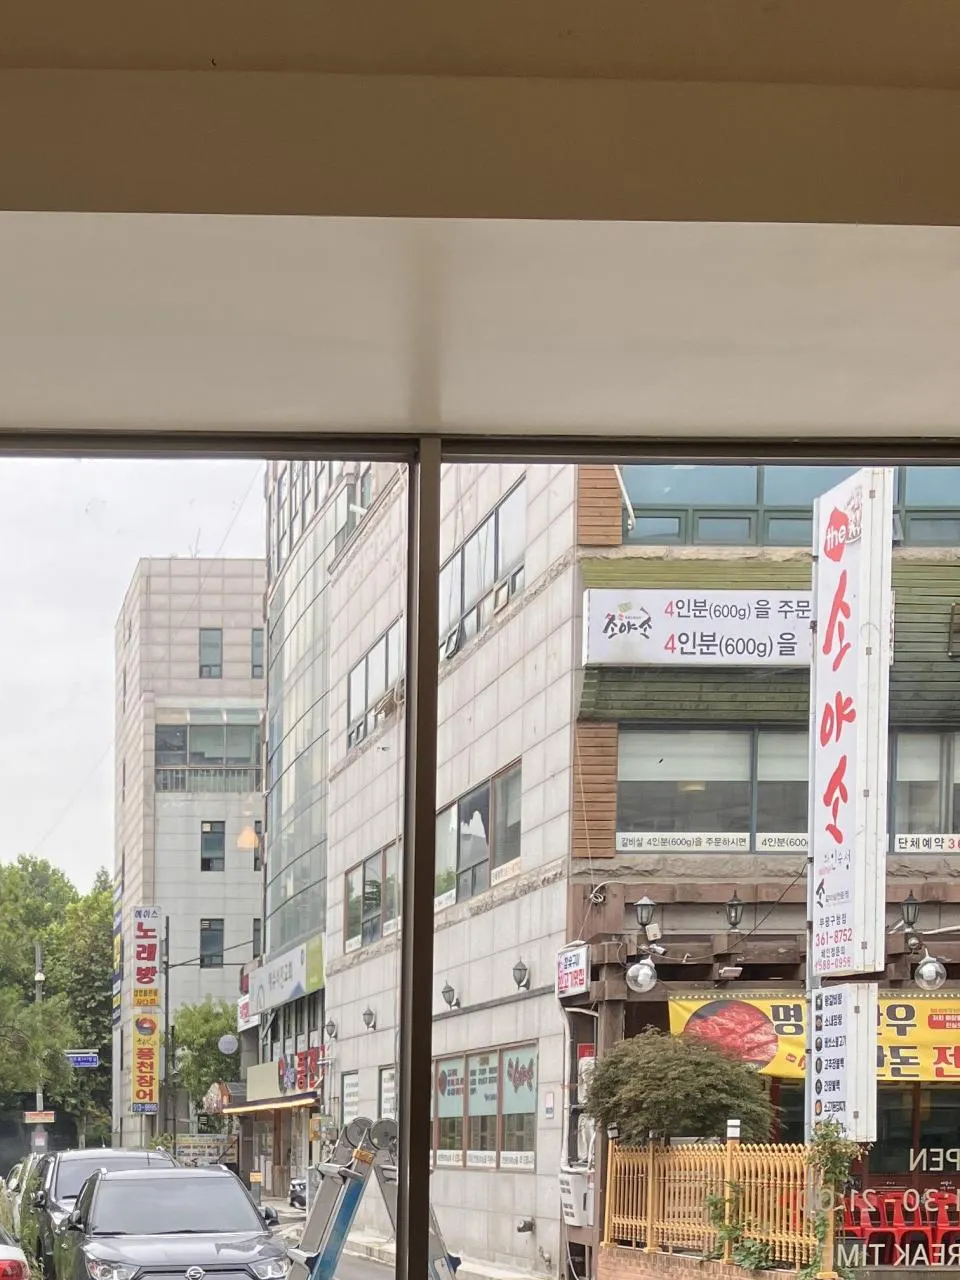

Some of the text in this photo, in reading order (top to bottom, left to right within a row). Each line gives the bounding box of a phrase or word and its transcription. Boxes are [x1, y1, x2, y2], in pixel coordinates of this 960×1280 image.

[705, 837, 747, 848] 주문하시면
[898, 836, 945, 850] 단체예약
[135, 921, 158, 985] 노래방
